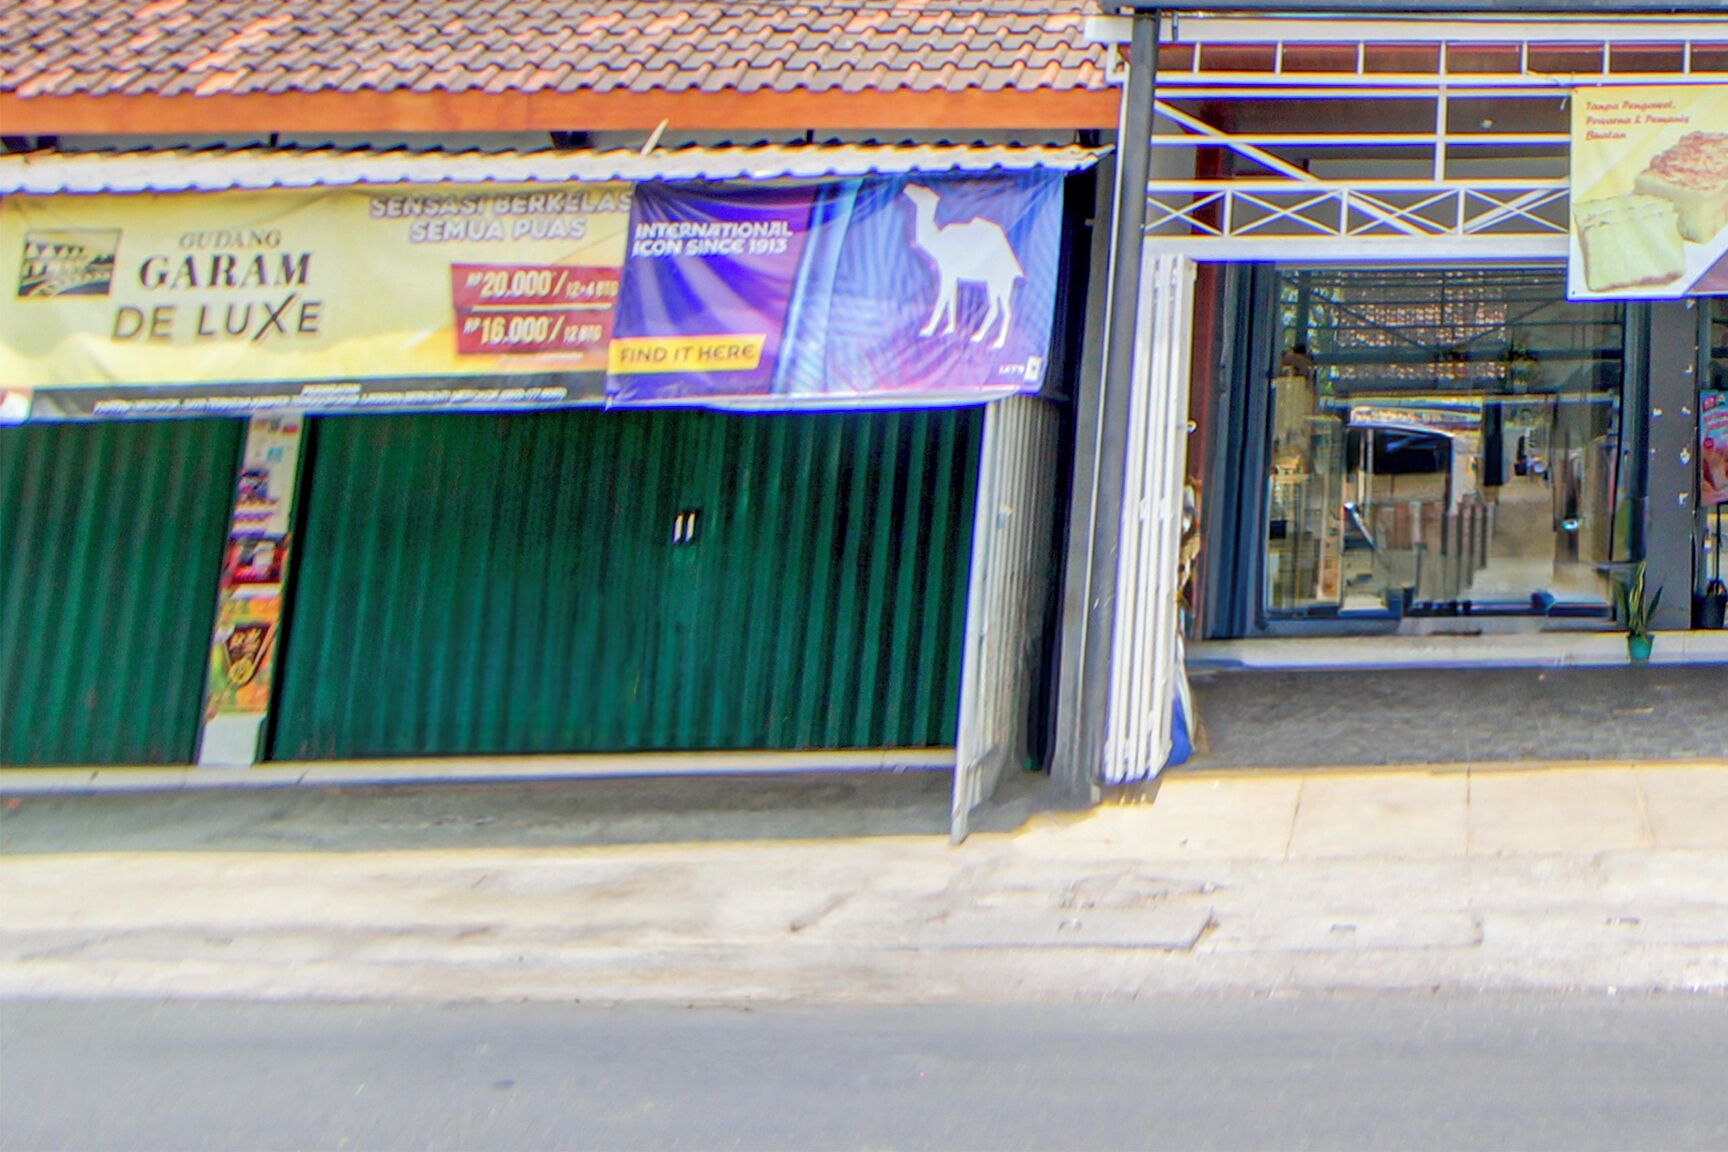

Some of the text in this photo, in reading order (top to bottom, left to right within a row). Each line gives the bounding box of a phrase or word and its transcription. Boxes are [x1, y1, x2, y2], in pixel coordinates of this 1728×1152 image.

[369, 191, 633, 219] SENSASI BERKELAS
[178, 228, 282, 249] GUDANG
[410, 218, 588, 243] SEMUA PUAS
[634, 220, 793, 240] INTERNATIONAL
[631, 238, 788, 257] ICON SINCE 1913
[138, 251, 313, 290] GARAM
[112, 292, 322, 342] DE LUXE
[620, 343, 755, 363] FIND IT HERE
